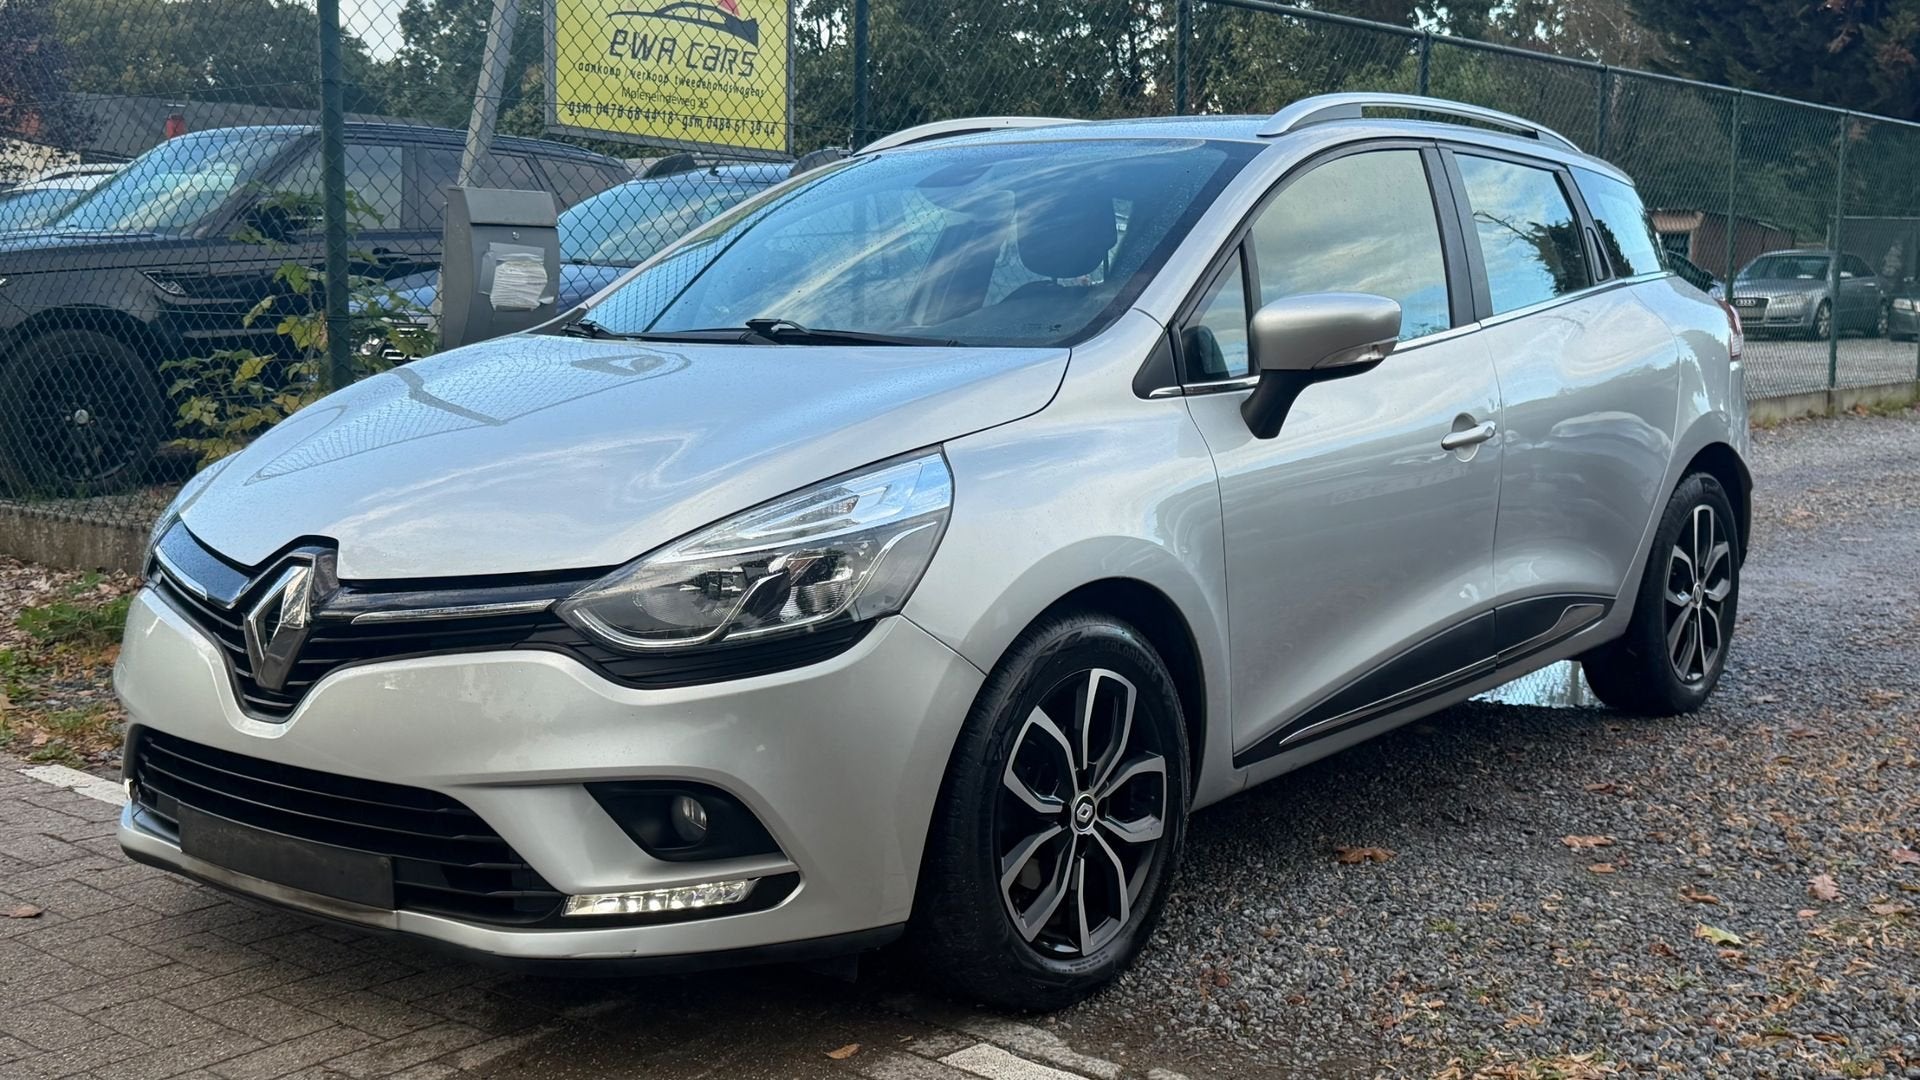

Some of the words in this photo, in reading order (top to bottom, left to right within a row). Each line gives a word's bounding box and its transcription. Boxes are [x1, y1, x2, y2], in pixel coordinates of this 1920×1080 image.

[578, 62, 621, 79] aankoop
[630, 69, 669, 86] verkoop
[675, 75, 765, 99] tweedehandswagens
[621, 87, 696, 110] Moleneindeweg
[568, 101, 592, 116] gsm
[627, 106, 641, 121] 68
[682, 115, 703, 130] gsm
[706, 117, 731, 132] 0484
[750, 120, 761, 136] 39
[764, 122, 776, 138] 44
